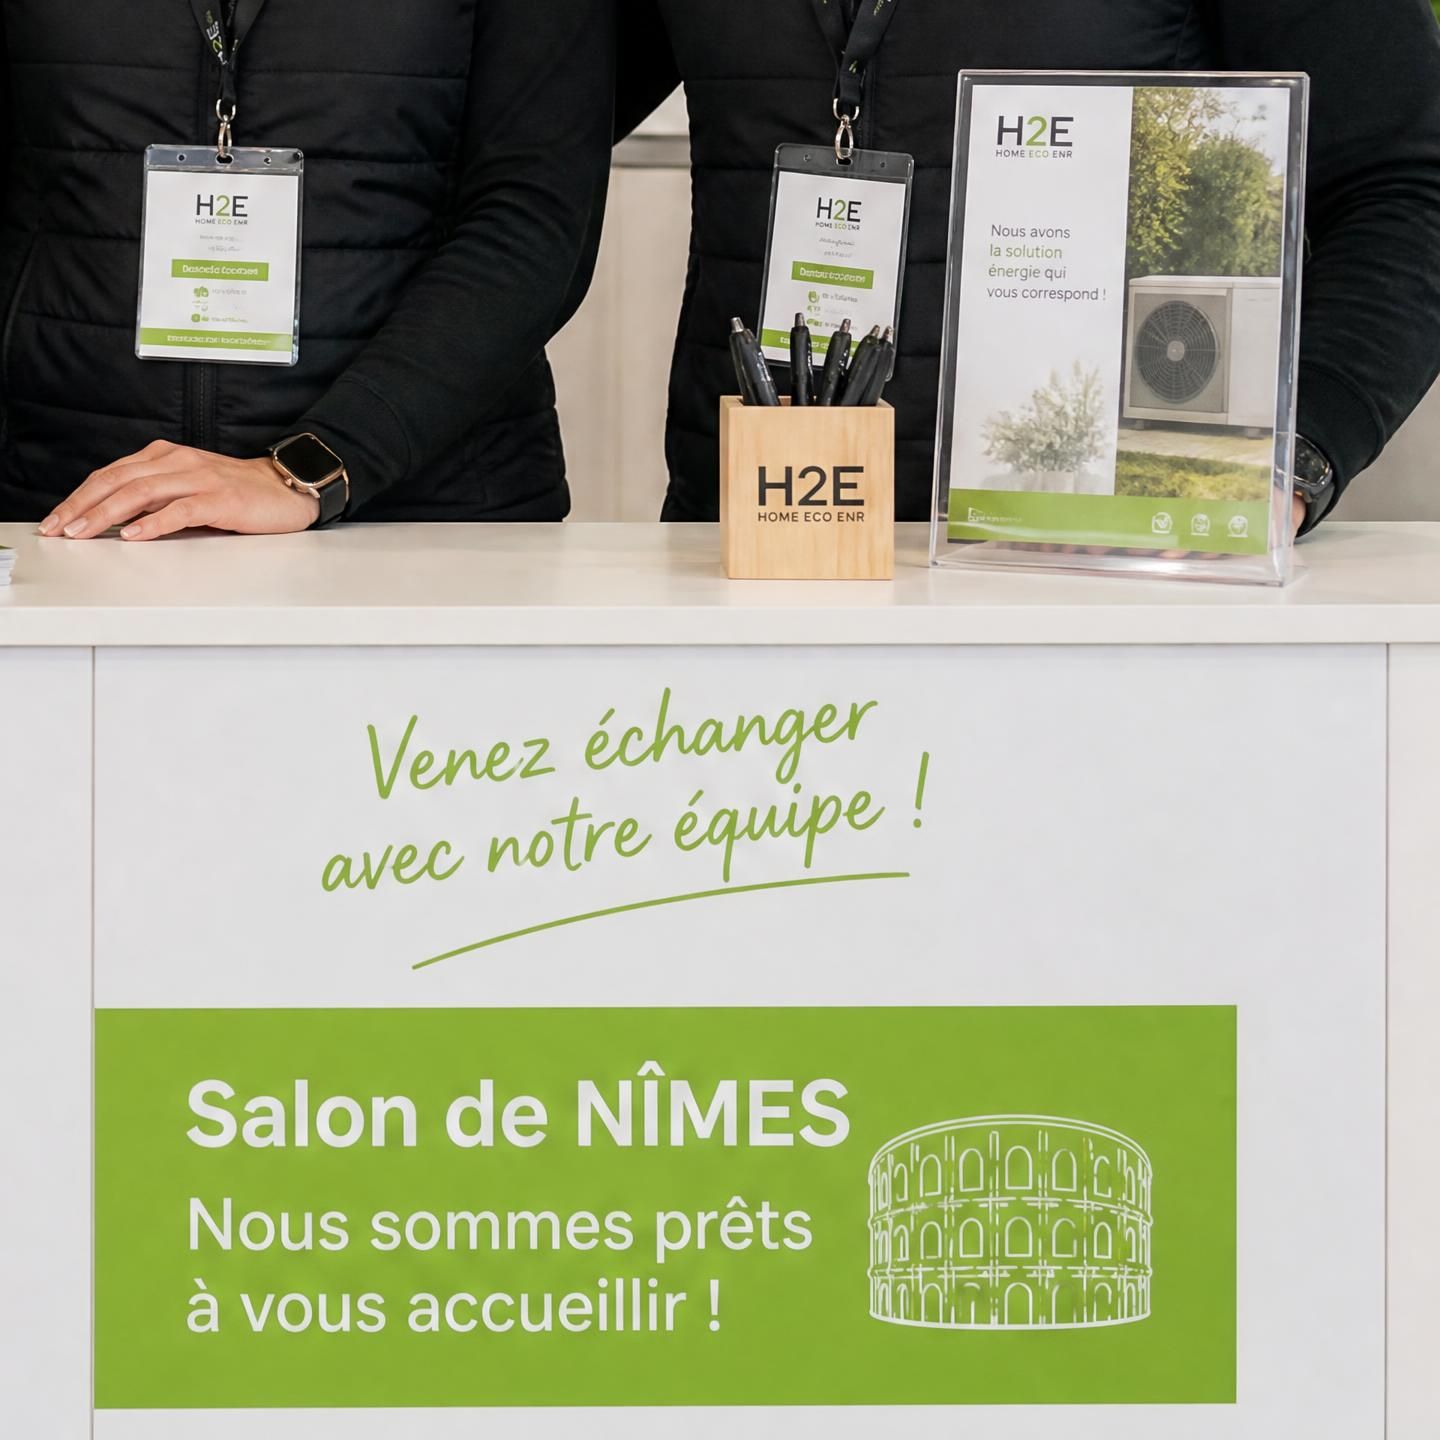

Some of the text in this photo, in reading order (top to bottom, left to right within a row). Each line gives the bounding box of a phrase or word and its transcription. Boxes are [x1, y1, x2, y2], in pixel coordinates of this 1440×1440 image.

[997, 115, 1074, 147] H2E
[995, 149, 1073, 159] HOME ECO ENR
[196, 194, 249, 217] H2E
[816, 197, 862, 222] H2E
[991, 224, 1071, 239] Nous avons
[990, 244, 1062, 259] la solution
[988, 263, 1066, 282] énergie qui
[987, 285, 1107, 304] vous correspond !
[758, 466, 864, 506] H2E
[758, 512, 864, 522] HOME ECO ENR
[367, 687, 878, 799] Venez échanger
[321, 751, 930, 892] avec notre équipe !
[186, 1060, 851, 1149] Salon de NÎMES
[187, 1197, 813, 1264] Nous sommes prêts
[186, 1277, 723, 1333] à vous accueillir !
